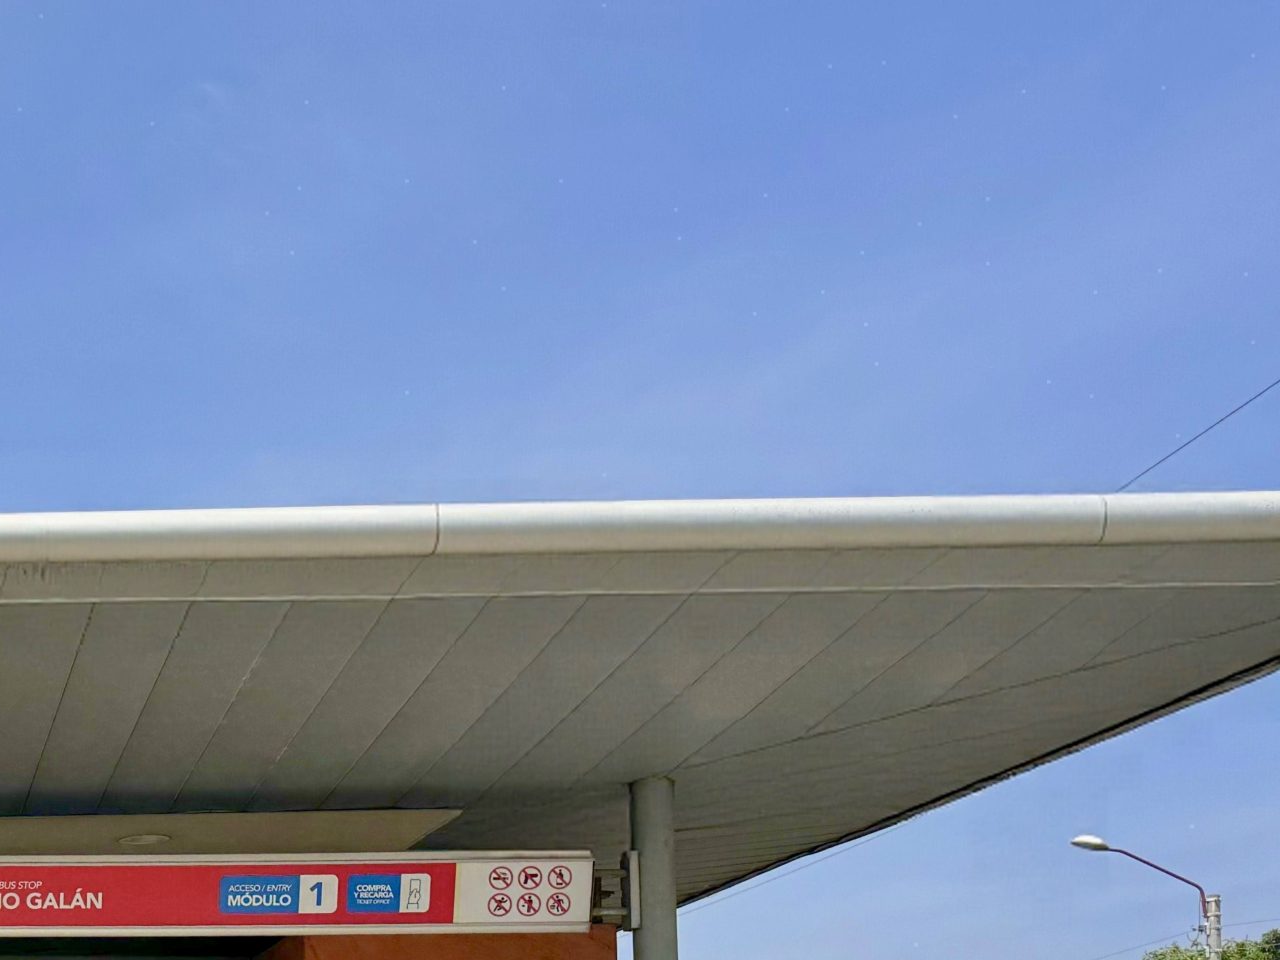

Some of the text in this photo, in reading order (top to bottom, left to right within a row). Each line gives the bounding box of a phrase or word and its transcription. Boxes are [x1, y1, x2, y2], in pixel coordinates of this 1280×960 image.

[18, 881, 43, 889] STOP
[228, 884, 261, 892] ACCESO
[266, 884, 293, 892] ENTRY
[356, 884, 392, 892] COMPRA
[227, 881, 323, 907] MÓDULO 1
[353, 891, 394, 899] Y RECARGA
[26, 888, 103, 910] GALÁN
